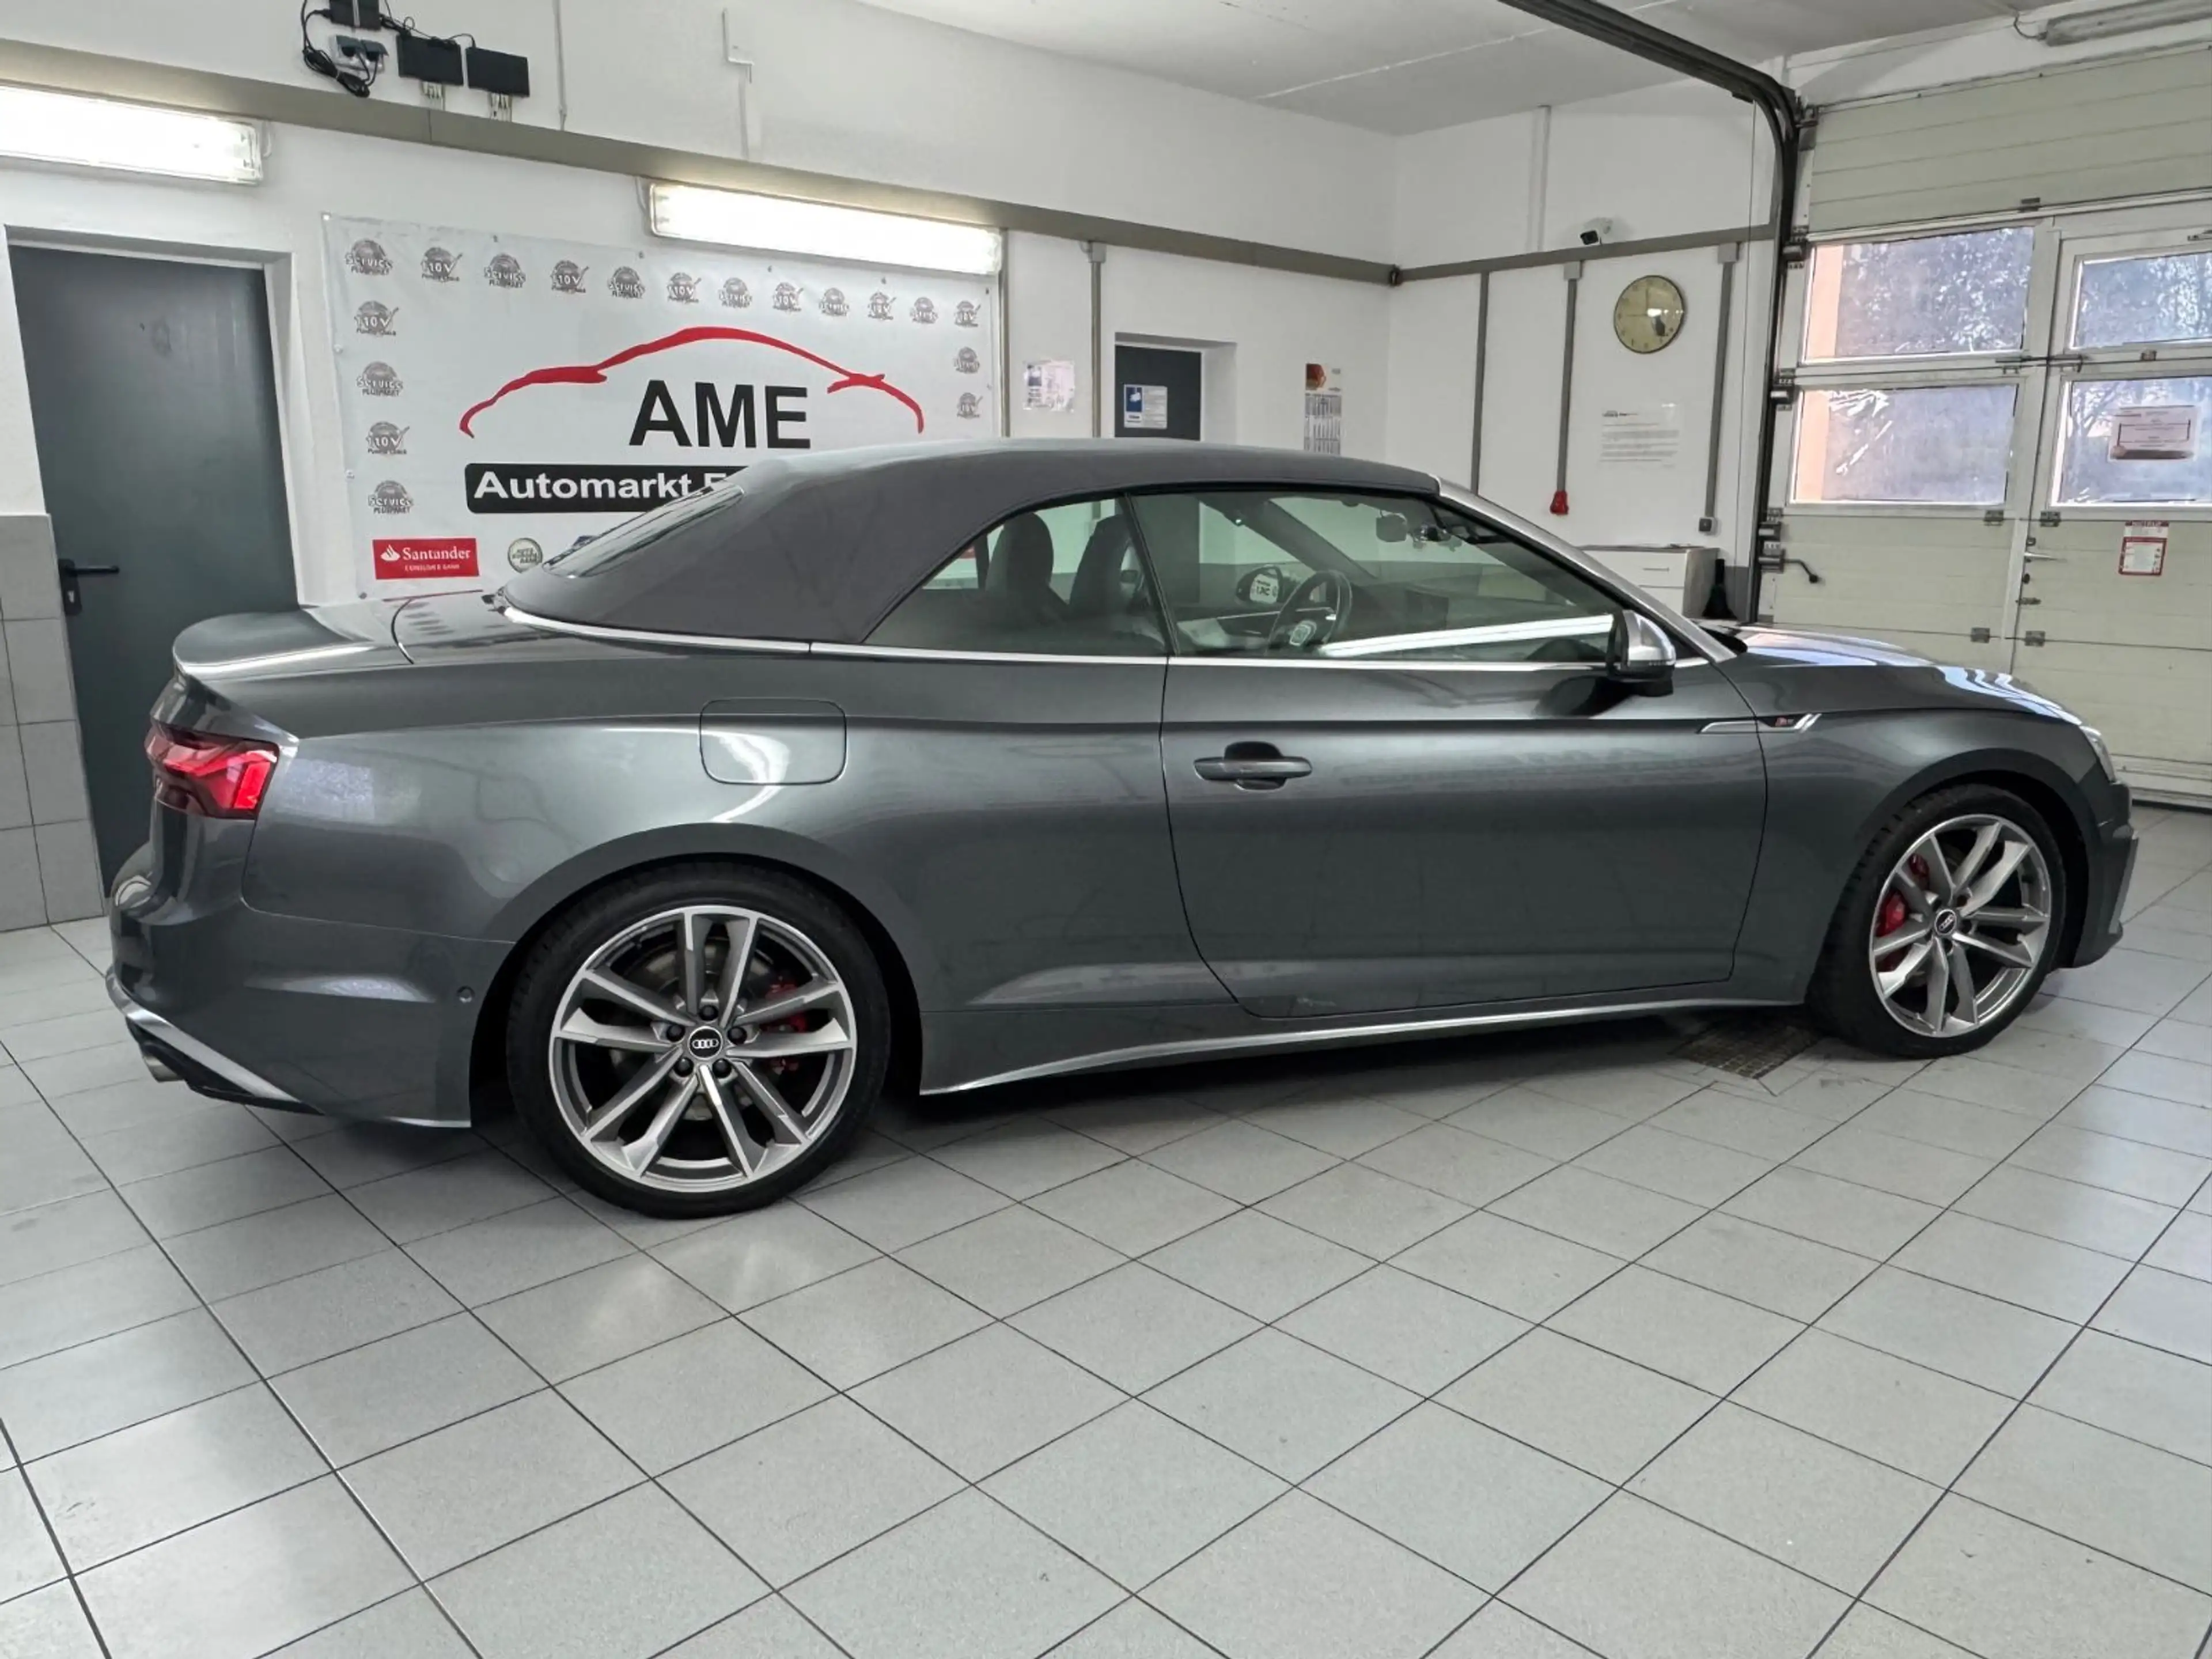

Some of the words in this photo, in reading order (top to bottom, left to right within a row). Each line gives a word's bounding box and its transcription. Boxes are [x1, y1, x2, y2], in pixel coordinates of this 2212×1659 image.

[628, 380, 811, 449] AME
[474, 471, 692, 499] Automarkt
[403, 546, 471, 560] Santander
